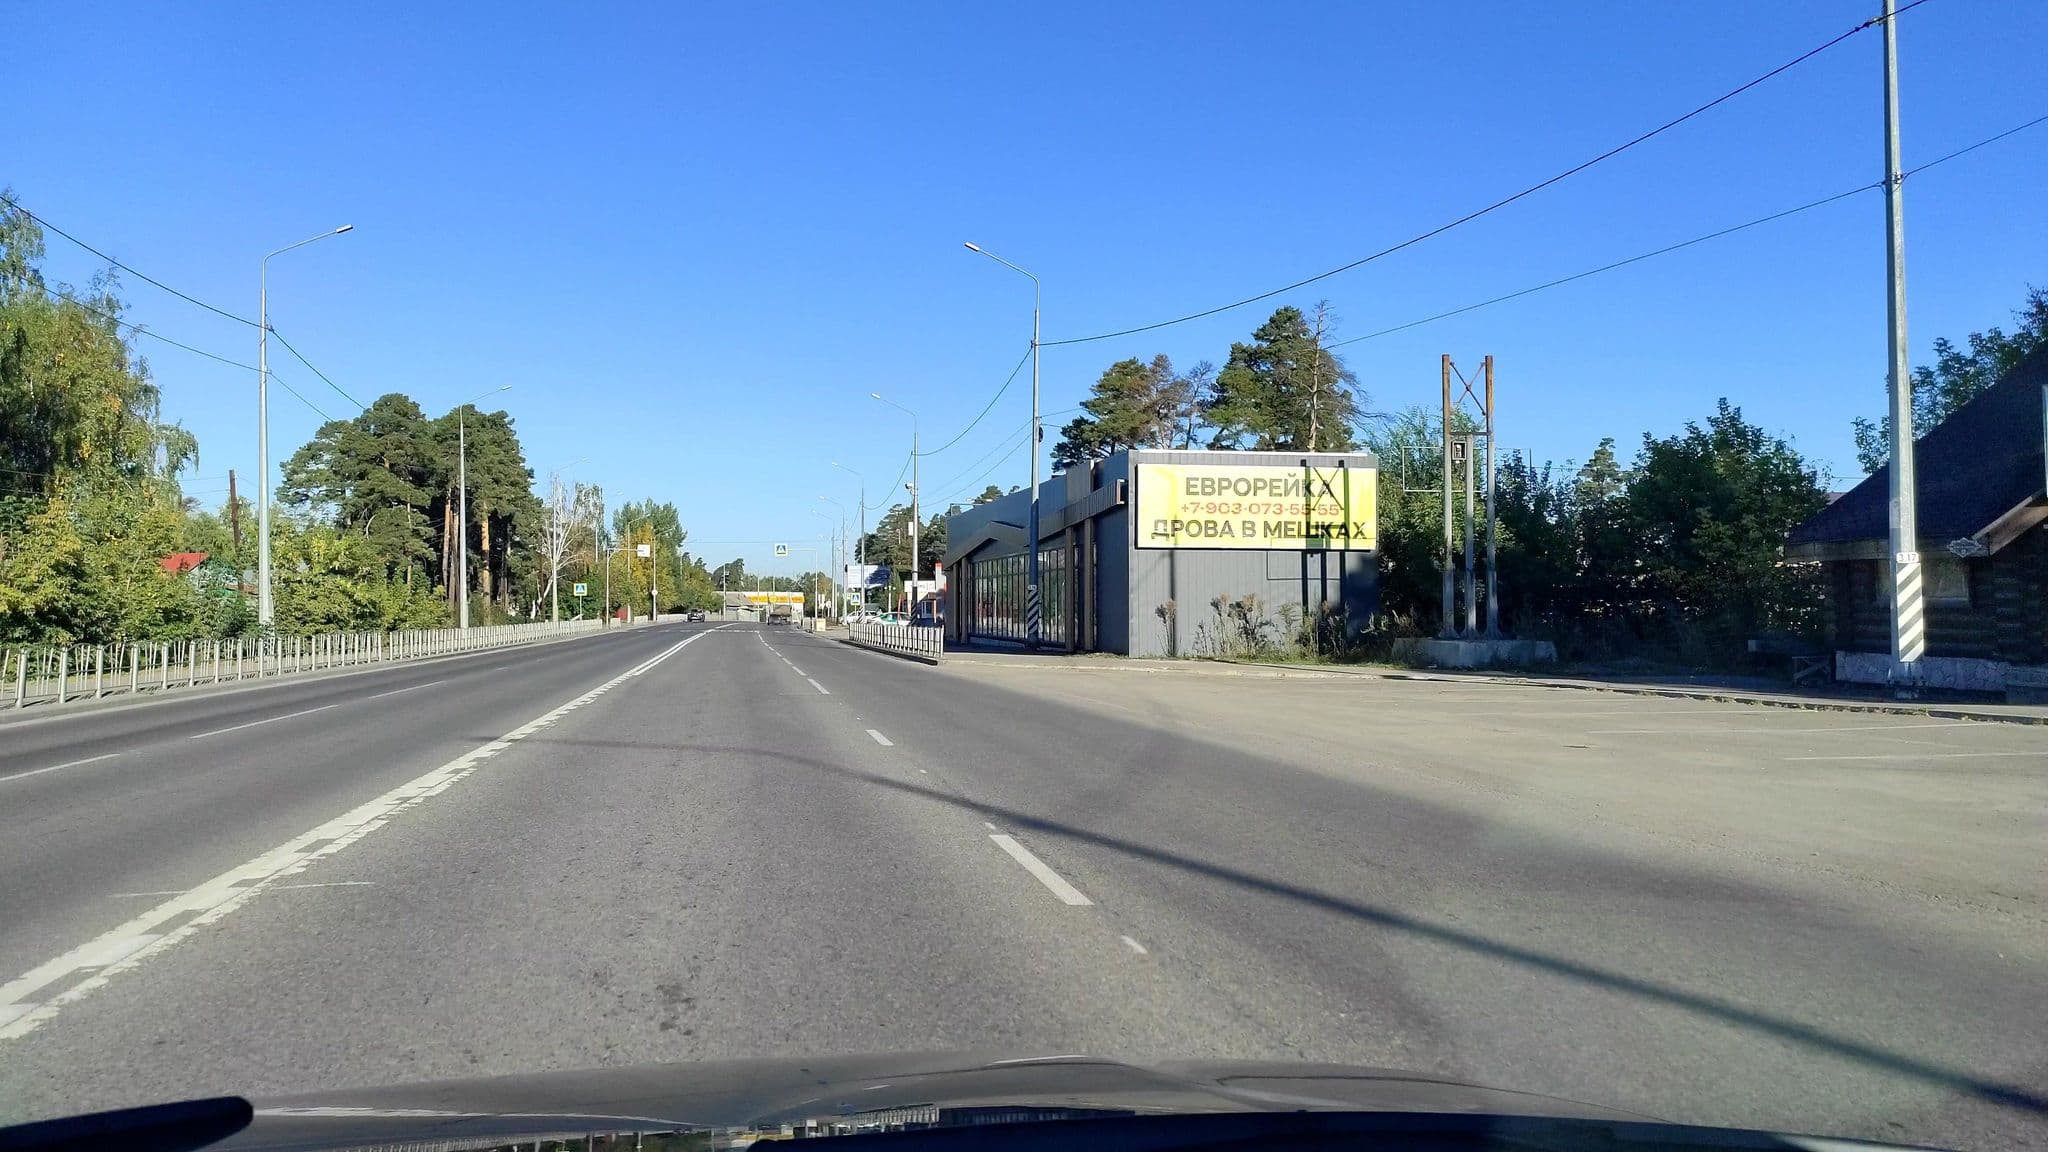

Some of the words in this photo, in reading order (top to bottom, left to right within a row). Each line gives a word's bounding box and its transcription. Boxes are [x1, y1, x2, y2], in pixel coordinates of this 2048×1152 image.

[1185, 473, 1334, 497] ЕВРОРЕЙКА
[1151, 519, 1235, 540] ДРОВА
[1242, 520, 1257, 538] В
[1263, 520, 1368, 539] МЕШКАХ
